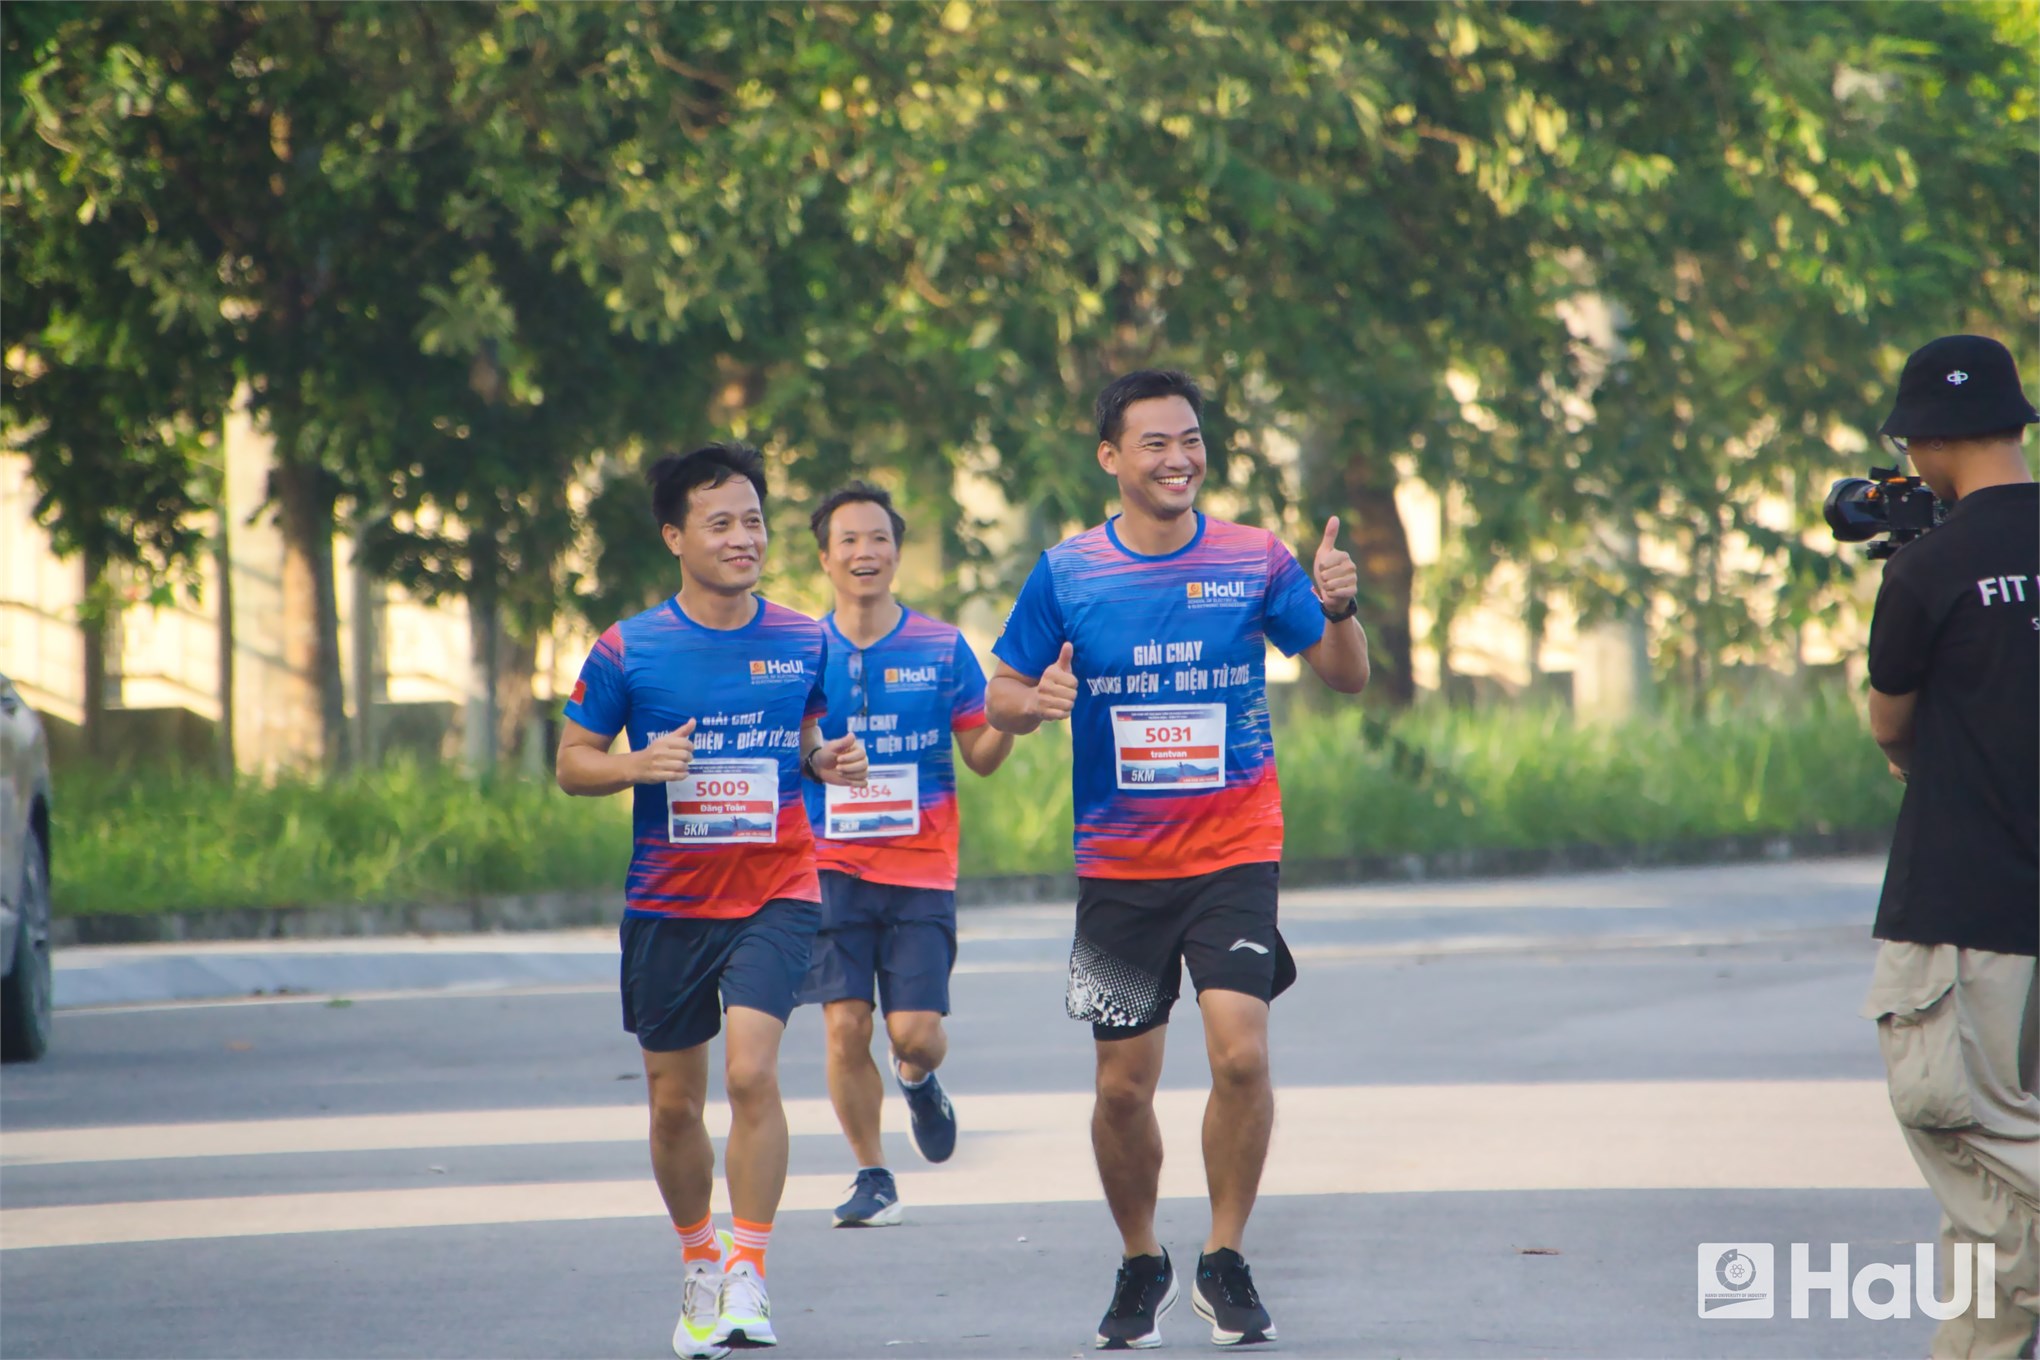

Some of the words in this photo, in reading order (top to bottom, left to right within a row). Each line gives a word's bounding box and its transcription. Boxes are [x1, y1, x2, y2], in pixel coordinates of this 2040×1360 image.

[1204, 581, 1245, 598] HaUI
[1977, 575, 2028, 606] FIT
[1134, 639, 1162, 666] GIẢI
[1166, 640, 1203, 666] CHẠY
[768, 660, 804, 674] HaUI
[900, 667, 936, 683] HaUI
[1175, 667, 1208, 695] ĐIỆN
[1145, 727, 1191, 743] 5031
[1150, 750, 1187, 758] trantvan
[1131, 769, 1155, 782] 5KM
[696, 781, 749, 797] 5009
[850, 785, 892, 798] 5054
[684, 824, 709, 836] 5KM
